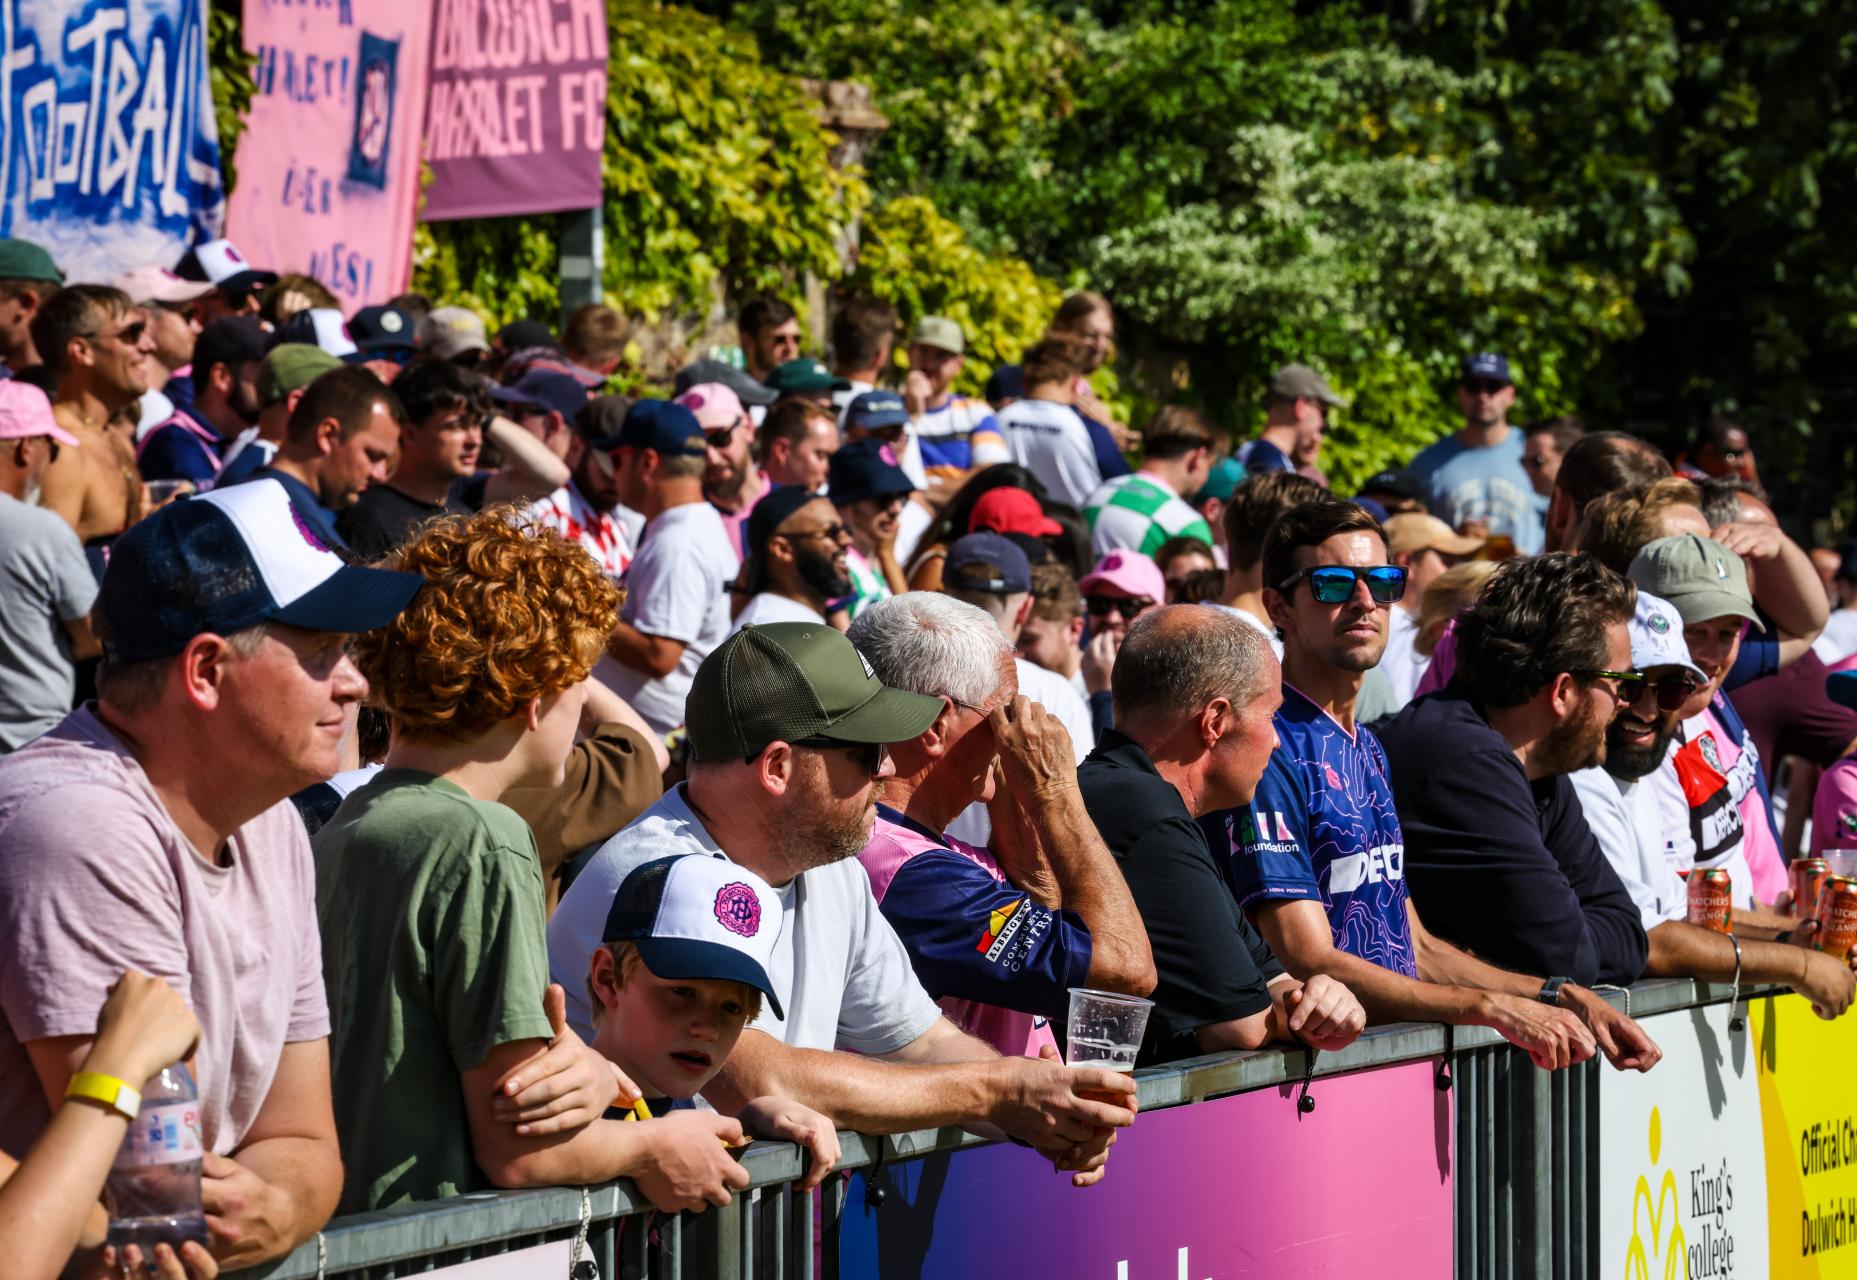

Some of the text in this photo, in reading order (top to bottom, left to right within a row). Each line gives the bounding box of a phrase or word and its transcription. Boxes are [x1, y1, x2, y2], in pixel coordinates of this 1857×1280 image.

[559, 69, 607, 150] FC
[1244, 842, 1300, 856] foundation
[1801, 1116, 1857, 1177] Official Ch
[1690, 1156, 1733, 1230] King's
[1687, 1223, 1734, 1280] college
[1802, 1197, 1857, 1257] Dulwich H
